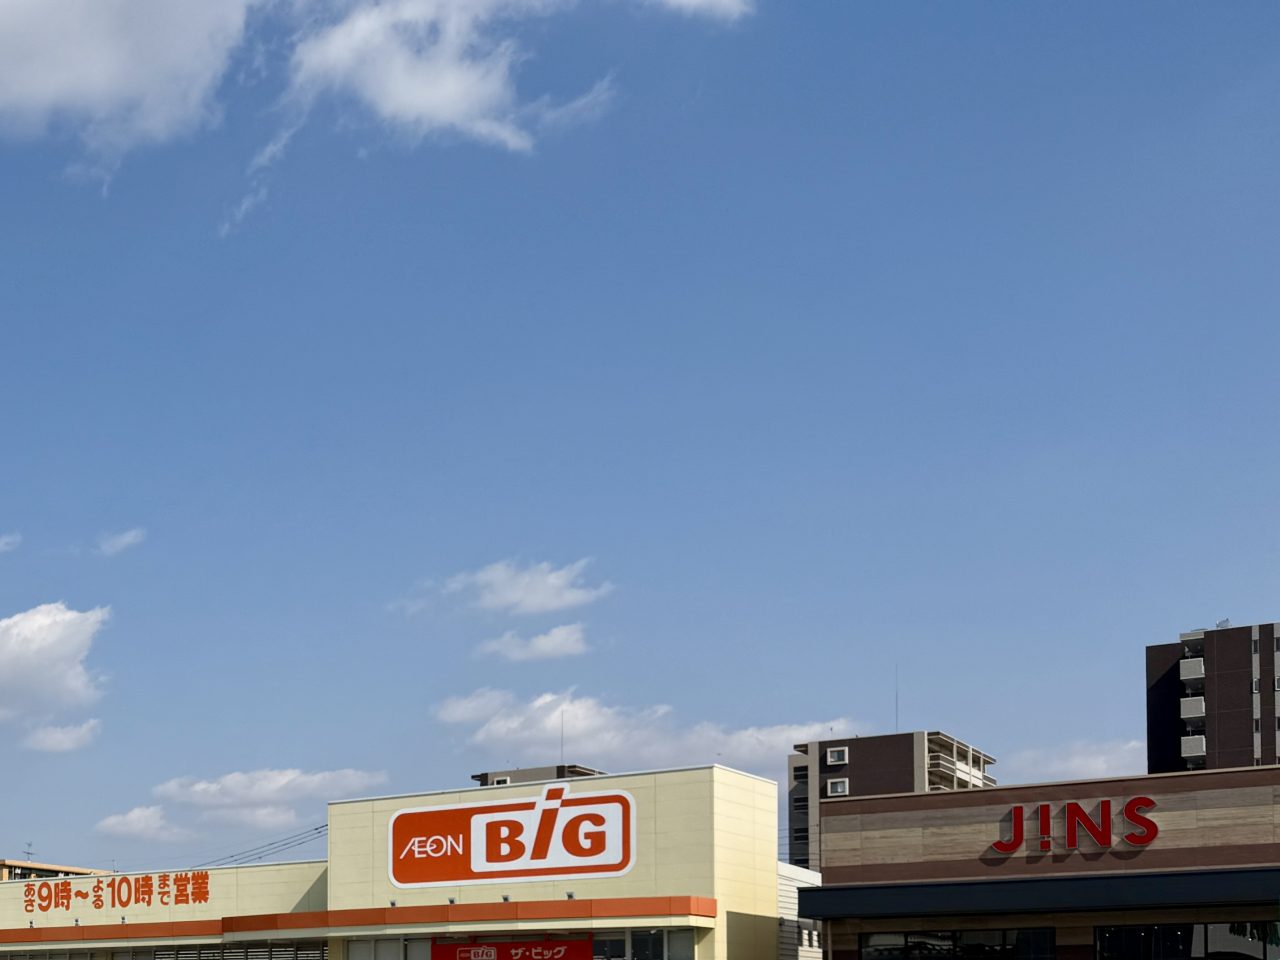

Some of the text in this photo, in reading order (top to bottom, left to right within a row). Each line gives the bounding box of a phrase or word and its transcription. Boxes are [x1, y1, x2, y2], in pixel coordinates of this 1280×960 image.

[510, 946, 567, 960] ザ・ビッグ
